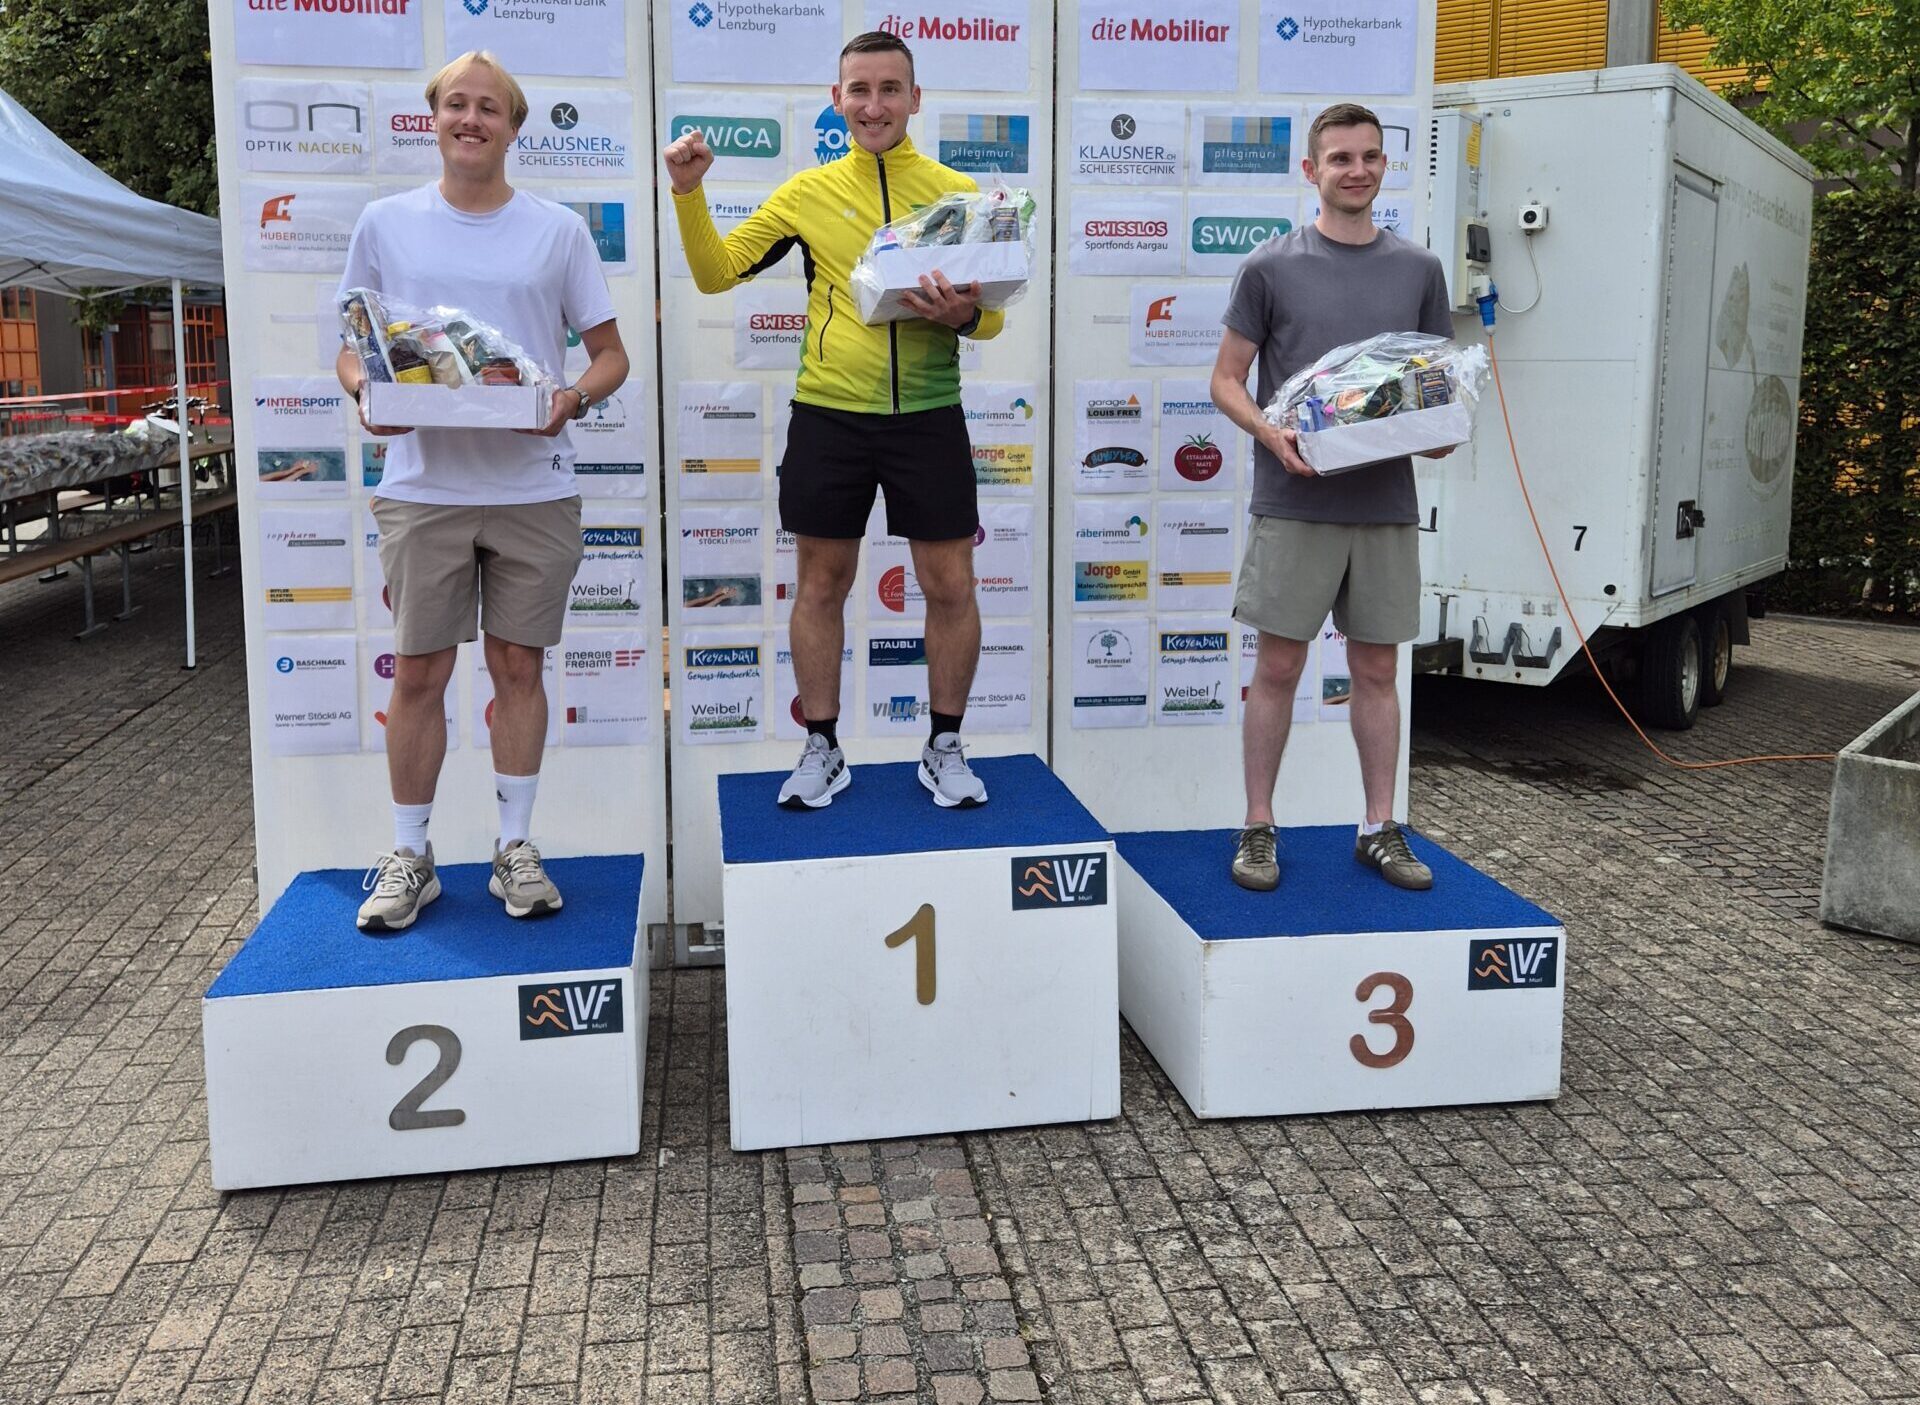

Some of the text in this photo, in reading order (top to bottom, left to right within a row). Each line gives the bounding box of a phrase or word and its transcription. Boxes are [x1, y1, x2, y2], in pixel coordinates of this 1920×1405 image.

[494, 8, 555, 24] Lenzburg
[718, 2, 825, 18] Hypothekarbank
[718, 19, 776, 34] Lenzburg
[879, 15, 1020, 42] die Mobiliar
[1091, 17, 1230, 42] die Mobiliar
[1303, 16, 1402, 31] Hypothekarbank
[1303, 33, 1356, 46] Lenzburg
[392, 114, 437, 133] SWIS
[245, 140, 362, 154] OPTIK NACKEN
[392, 136, 437, 147] Sportfon
[951, 147, 1014, 159] pflegimuri
[1214, 148, 1276, 161] pflegimuri
[518, 155, 625, 167] SCHLIESSTECHNIK
[1080, 163, 1175, 175] SCHLIESSTECHNIK
[715, 204, 752, 214] Pratter
[1385, 208, 1398, 218] AG
[1085, 221, 1168, 237] SWISSLOS
[260, 232, 352, 242] HUBERDRUCKERE
[1085, 240, 1168, 251] Sportfonds Aargau
[750, 315, 808, 330] SWISS
[750, 333, 802, 345] Sportfonds
[1145, 330, 1222, 338] HUBERDRUCKERE
[266, 397, 341, 407] INTERSPORT
[684, 403, 730, 412] toppharm
[1088, 399, 1127, 407] garage
[964, 409, 1015, 420] äberimmo
[1116, 409, 1140, 417] FREY
[971, 445, 1005, 462] Jorge
[267, 530, 317, 540] toppharm
[582, 529, 637, 546] reyenbühl
[692, 527, 759, 538] INTERSPORT
[1076, 529, 1130, 538] räberimmo
[1572, 525, 1588, 551] 7
[1083, 562, 1121, 579] Jorge
[981, 577, 1014, 585] MIGROS
[571, 584, 622, 596] Weibel
[981, 585, 1029, 594] Kulturprozent
[296, 659, 346, 667] BASCHNAGEL
[967, 695, 987, 703] erner
[1014, 693, 1026, 702] AG
[1164, 685, 1209, 698] Weibel
[691, 702, 740, 715] Weibel
[872, 701, 930, 718] VILLIGE
[275, 712, 306, 722] Werner
[338, 711, 352, 720] AG
[1053, 857, 1101, 902] LVF
[884, 902, 937, 1006] 1
[1508, 942, 1553, 984] LVF
[563, 983, 617, 1031] LVF
[1349, 971, 1415, 1069] 3
[386, 1024, 466, 1131] 2
